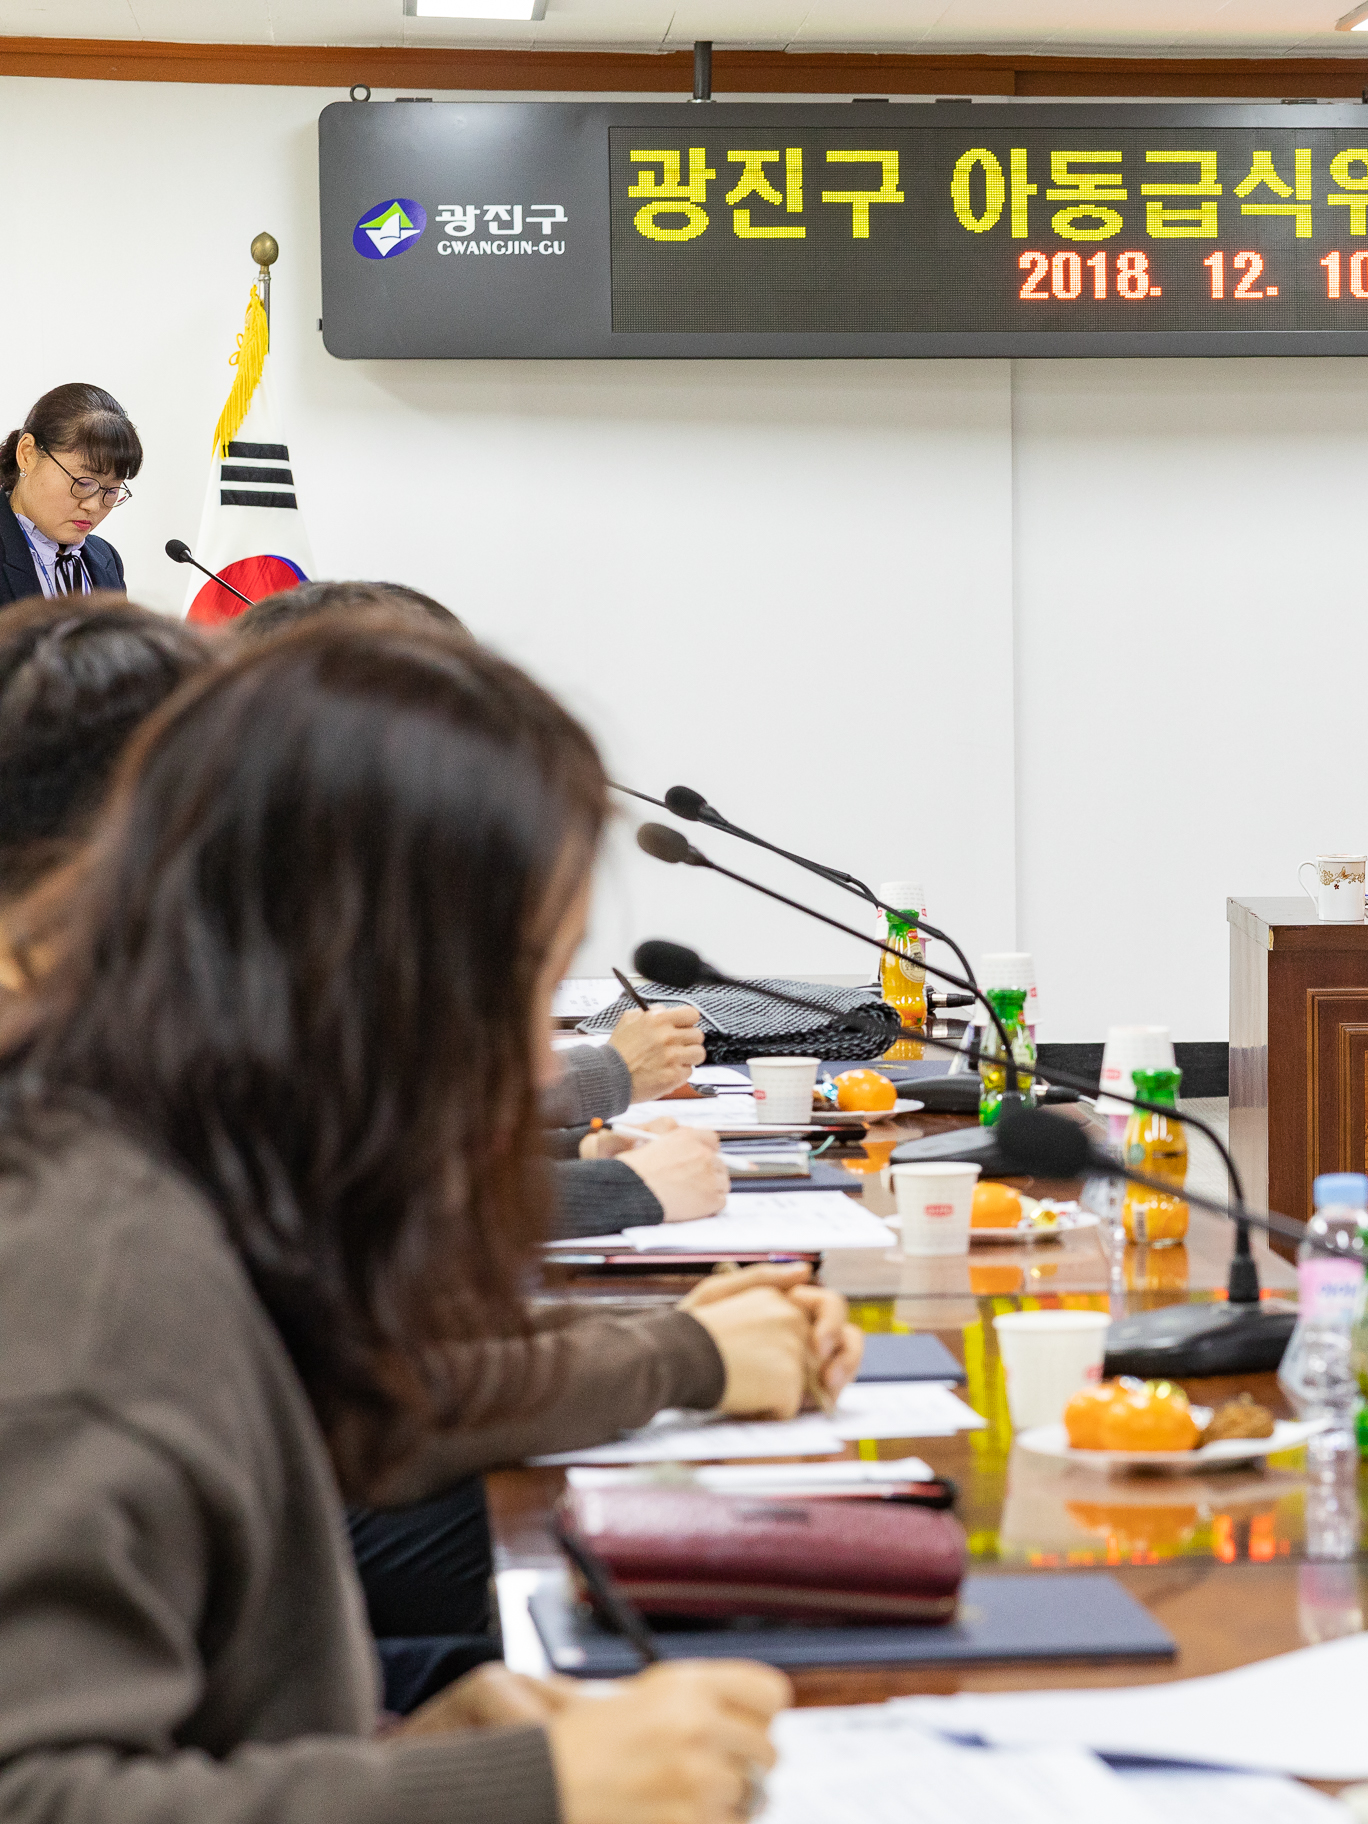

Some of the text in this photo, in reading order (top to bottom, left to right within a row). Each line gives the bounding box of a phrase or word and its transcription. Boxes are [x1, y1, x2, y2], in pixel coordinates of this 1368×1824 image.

[627, 147, 905, 242] 광진구
[435, 204, 568, 237] 광진구
[437, 240, 567, 256] GWANGJIN-GU
[1018, 249, 1163, 301] 2018.
[1203, 249, 1280, 301] 12.
